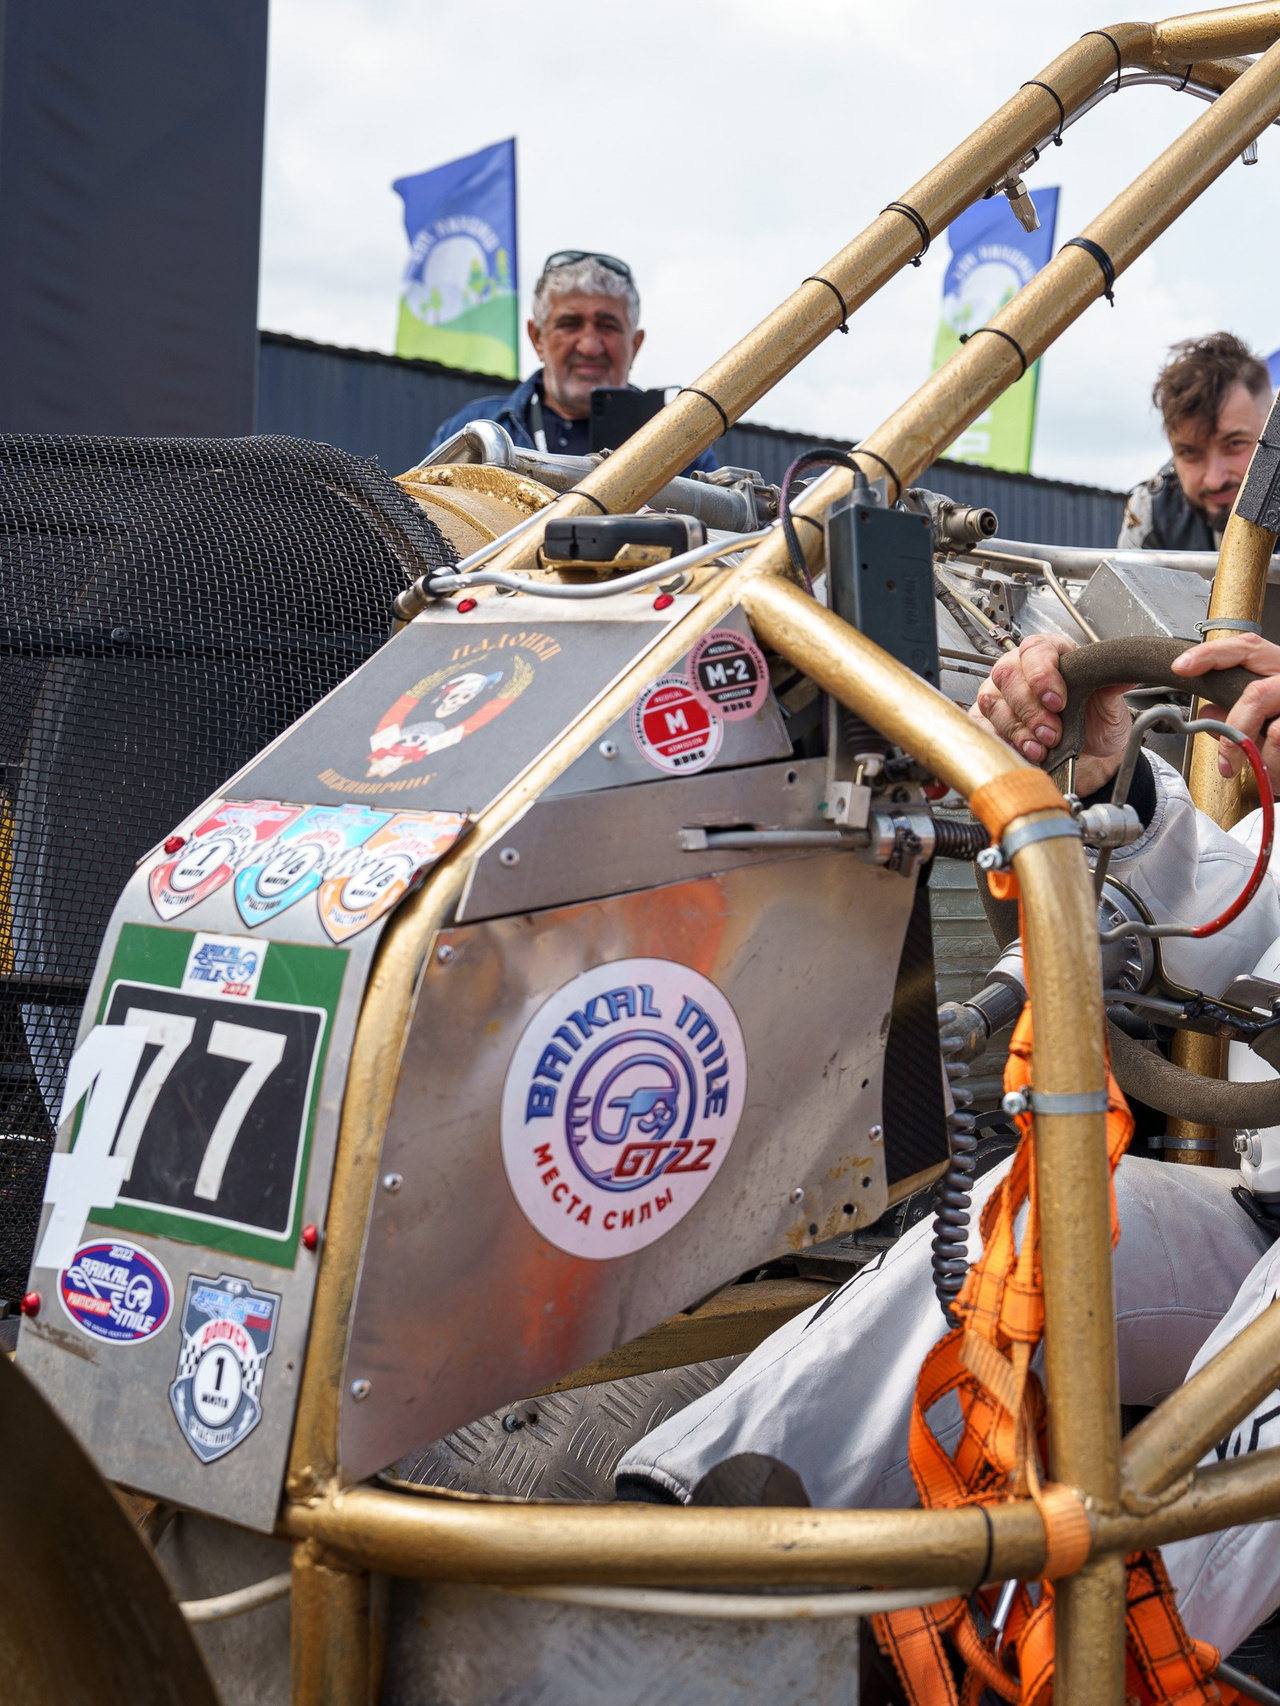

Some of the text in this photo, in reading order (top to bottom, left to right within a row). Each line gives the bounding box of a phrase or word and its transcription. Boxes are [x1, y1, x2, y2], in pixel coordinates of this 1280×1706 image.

[705, 658, 750, 687] M-2
[664, 708, 689, 735] M
[525, 984, 730, 1125] BAIKAL MILE
[614, 1138, 717, 1178] GT22
[533, 1142, 673, 1230] МЕСТА СИЛЫ
[80, 1257, 130, 1286] BAIKAL
[114, 1308, 156, 1334] MILE
[215, 1357, 225, 1391] 1
